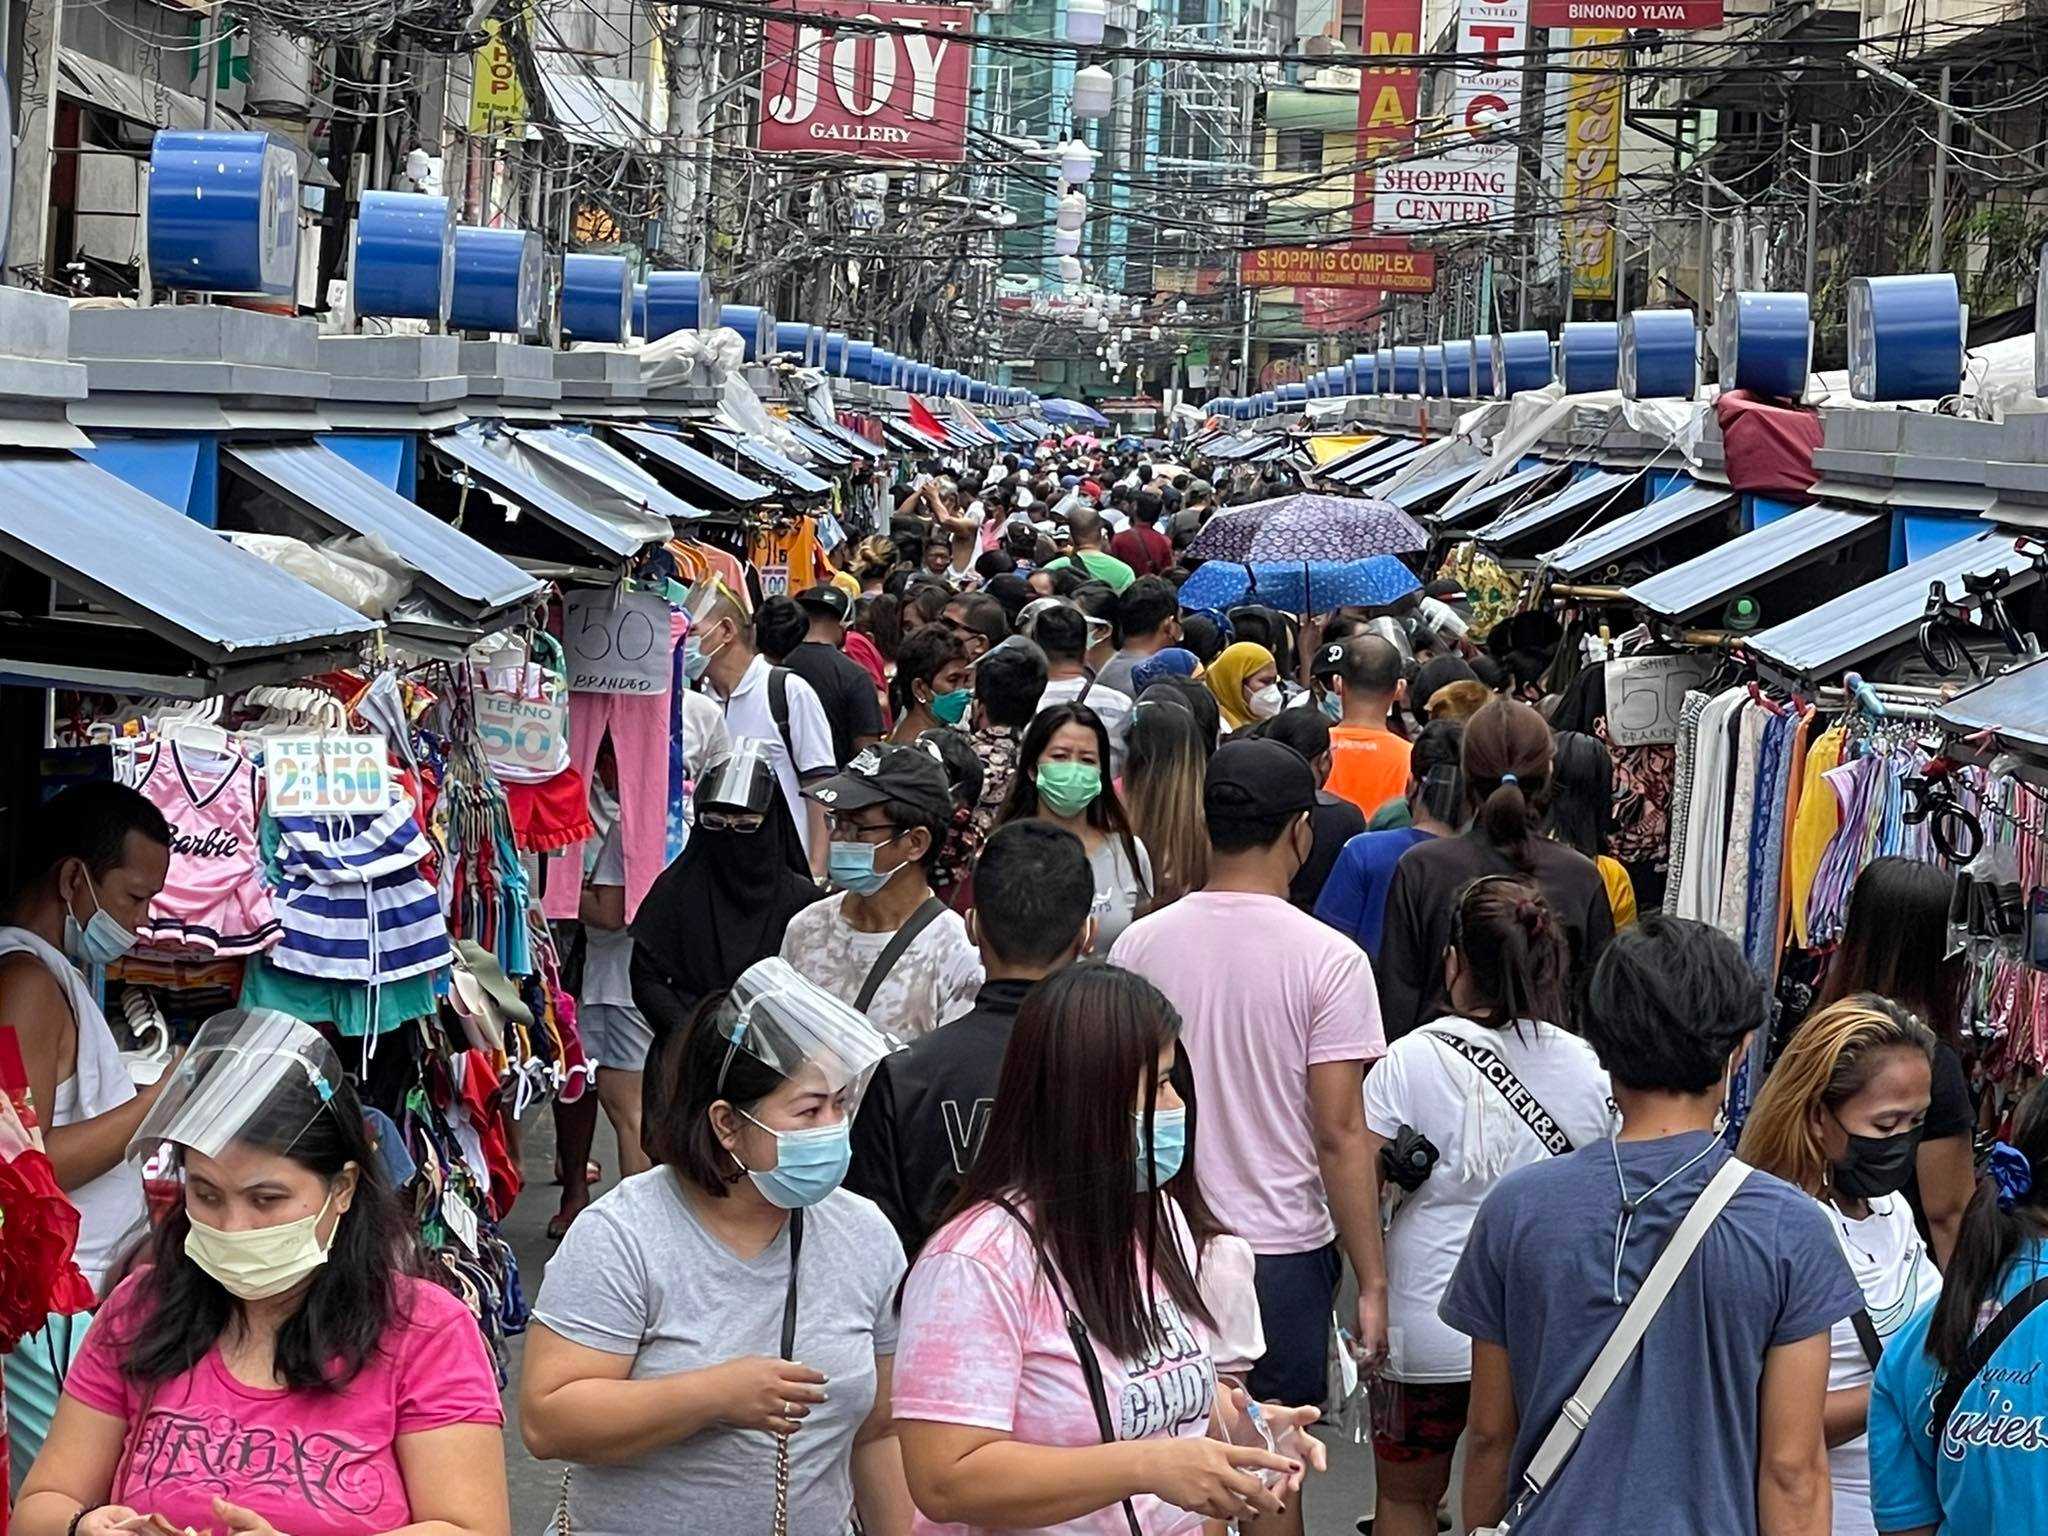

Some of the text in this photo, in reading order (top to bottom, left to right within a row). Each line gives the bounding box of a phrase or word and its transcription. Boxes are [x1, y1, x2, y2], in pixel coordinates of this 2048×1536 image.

[1568, 4, 1685, 19] BINONDO YLAYA
[490, 37, 513, 96] HOP
[768, 13, 963, 124] JOY
[810, 122, 912, 143] GALLERY
[1383, 168, 1506, 194] SHOPPING
[1396, 198, 1490, 222] CENTER
[1257, 249, 1415, 273] SHOPPING COMPLEX
[574, 607, 654, 661] 50
[573, 675, 651, 692] BRANDED
[485, 697, 552, 720] TERNO
[276, 741, 373, 756] TERNO
[479, 712, 552, 762] 50
[312, 756, 381, 805] 150
